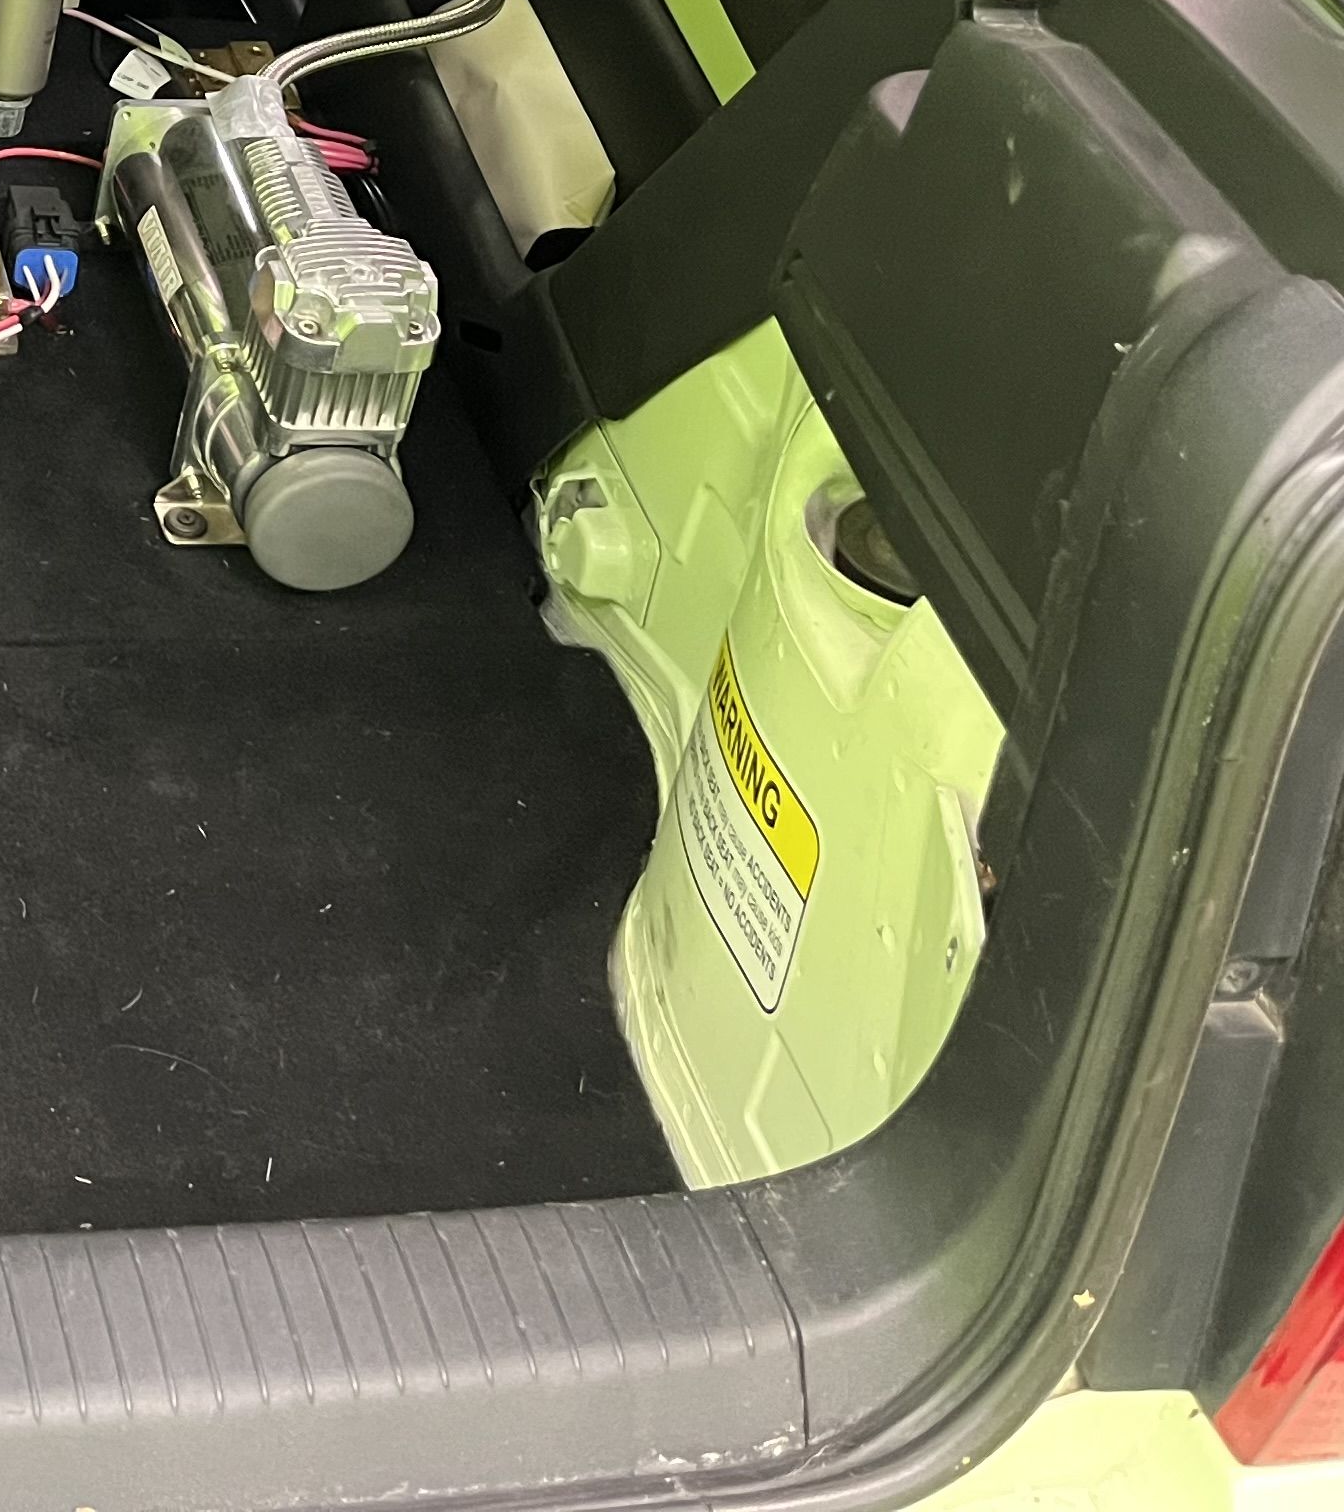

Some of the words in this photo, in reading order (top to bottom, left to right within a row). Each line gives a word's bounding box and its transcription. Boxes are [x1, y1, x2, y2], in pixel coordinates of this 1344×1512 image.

[140, 210, 180, 299] VIAIR
[713, 658, 781, 829] WARNING
[716, 832, 734, 871] SEAT
[746, 854, 792, 934] ACCIDENTS
[703, 842, 720, 880] SEAT
[723, 881, 735, 910] NO
[733, 903, 776, 981] ACCIDENTS
